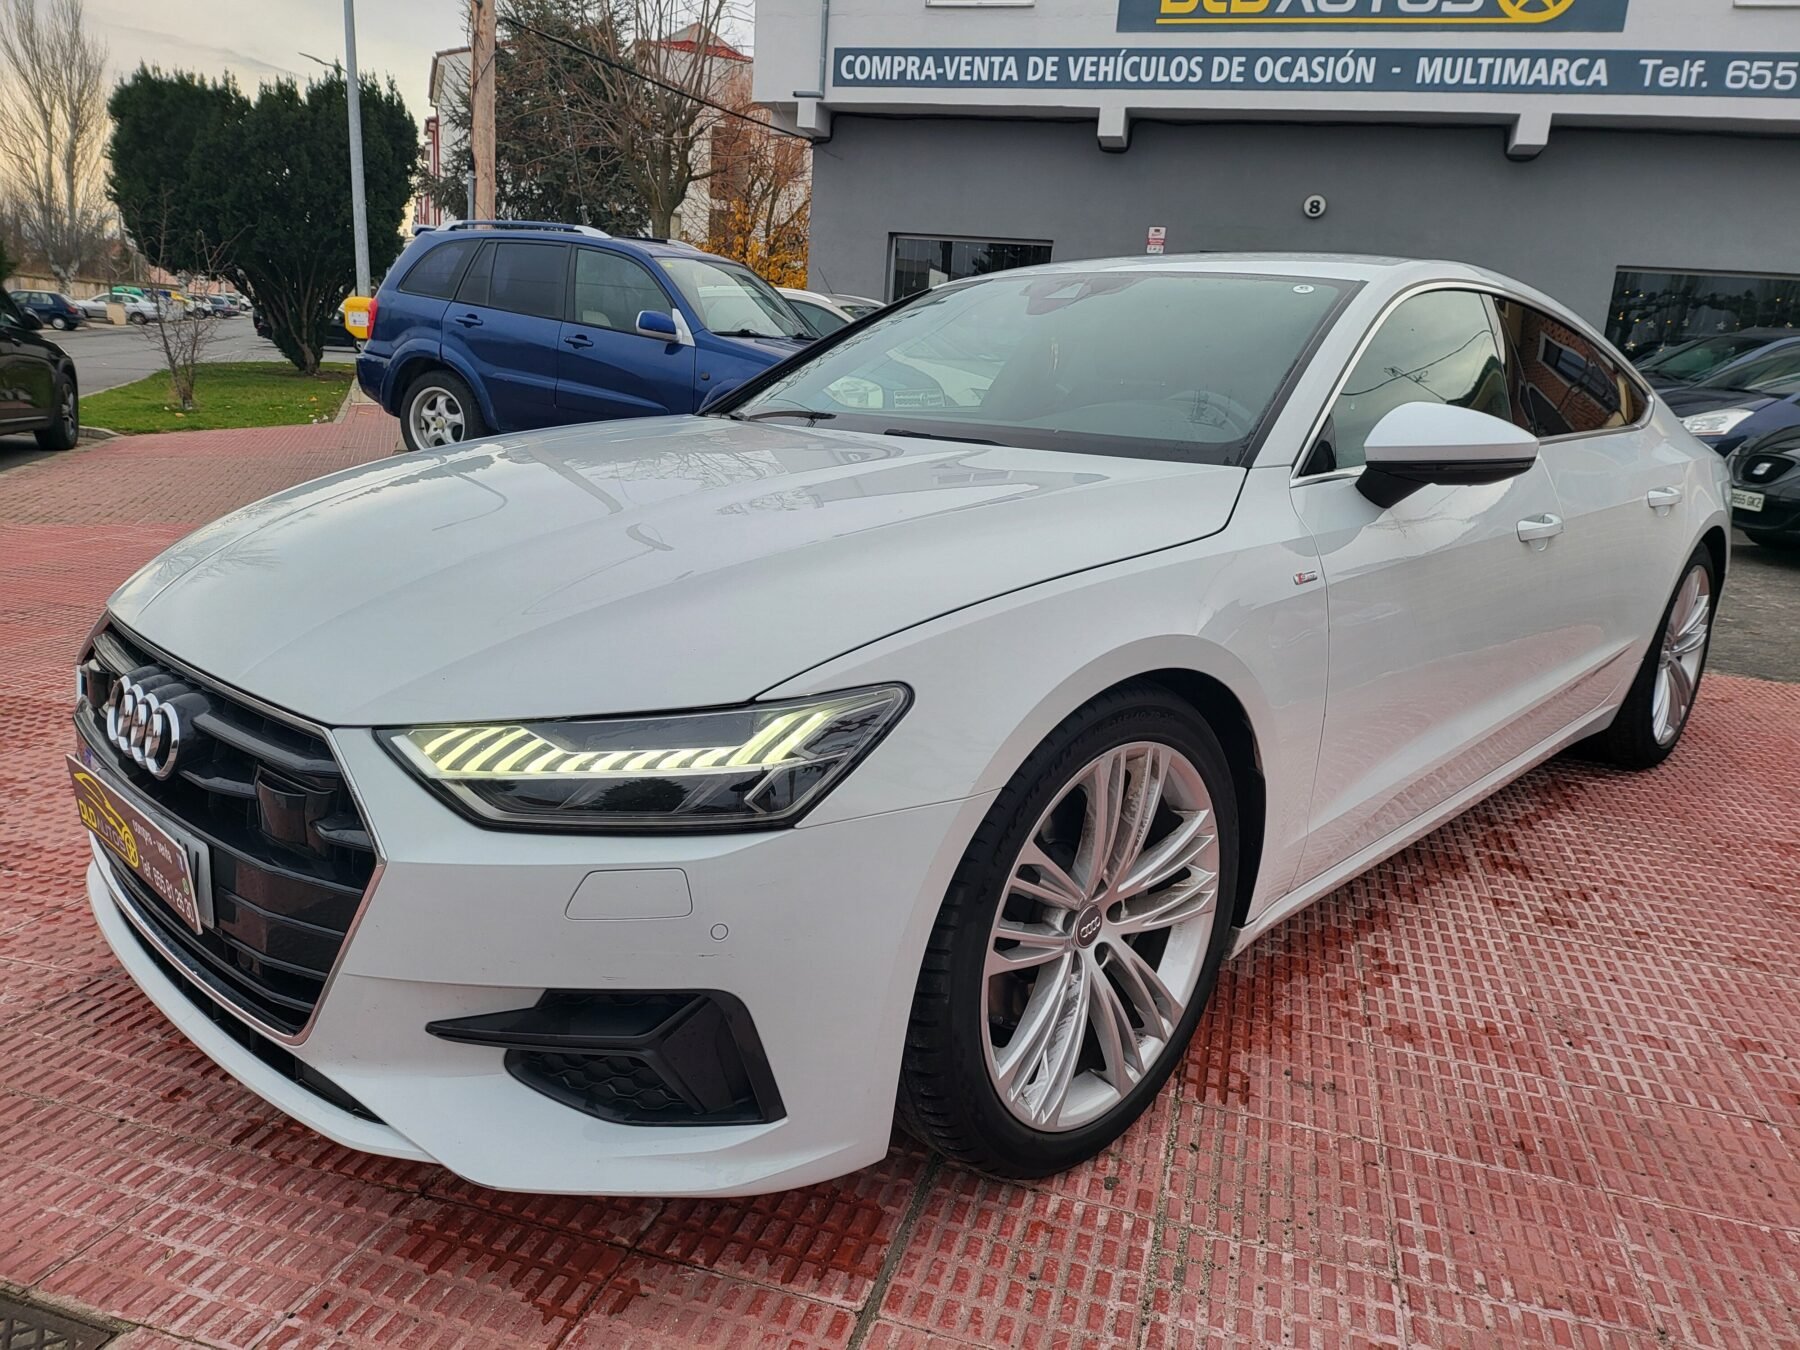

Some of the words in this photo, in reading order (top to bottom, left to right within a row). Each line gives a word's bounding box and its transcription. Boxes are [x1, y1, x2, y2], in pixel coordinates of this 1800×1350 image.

[840, 55, 1019, 82] COMPRA-VENTA
[1026, 56, 1059, 82] DE
[1068, 50, 1204, 83] VEHÍCULOS
[1210, 56, 1247, 83] DE
[1254, 50, 1377, 84] OCASIÓN
[1415, 57, 1608, 87] MULTIMARCA
[1639, 58, 1708, 88] Telf.
[1725, 60, 1799, 91] 655
[1309, 200, 1321, 214] 8
